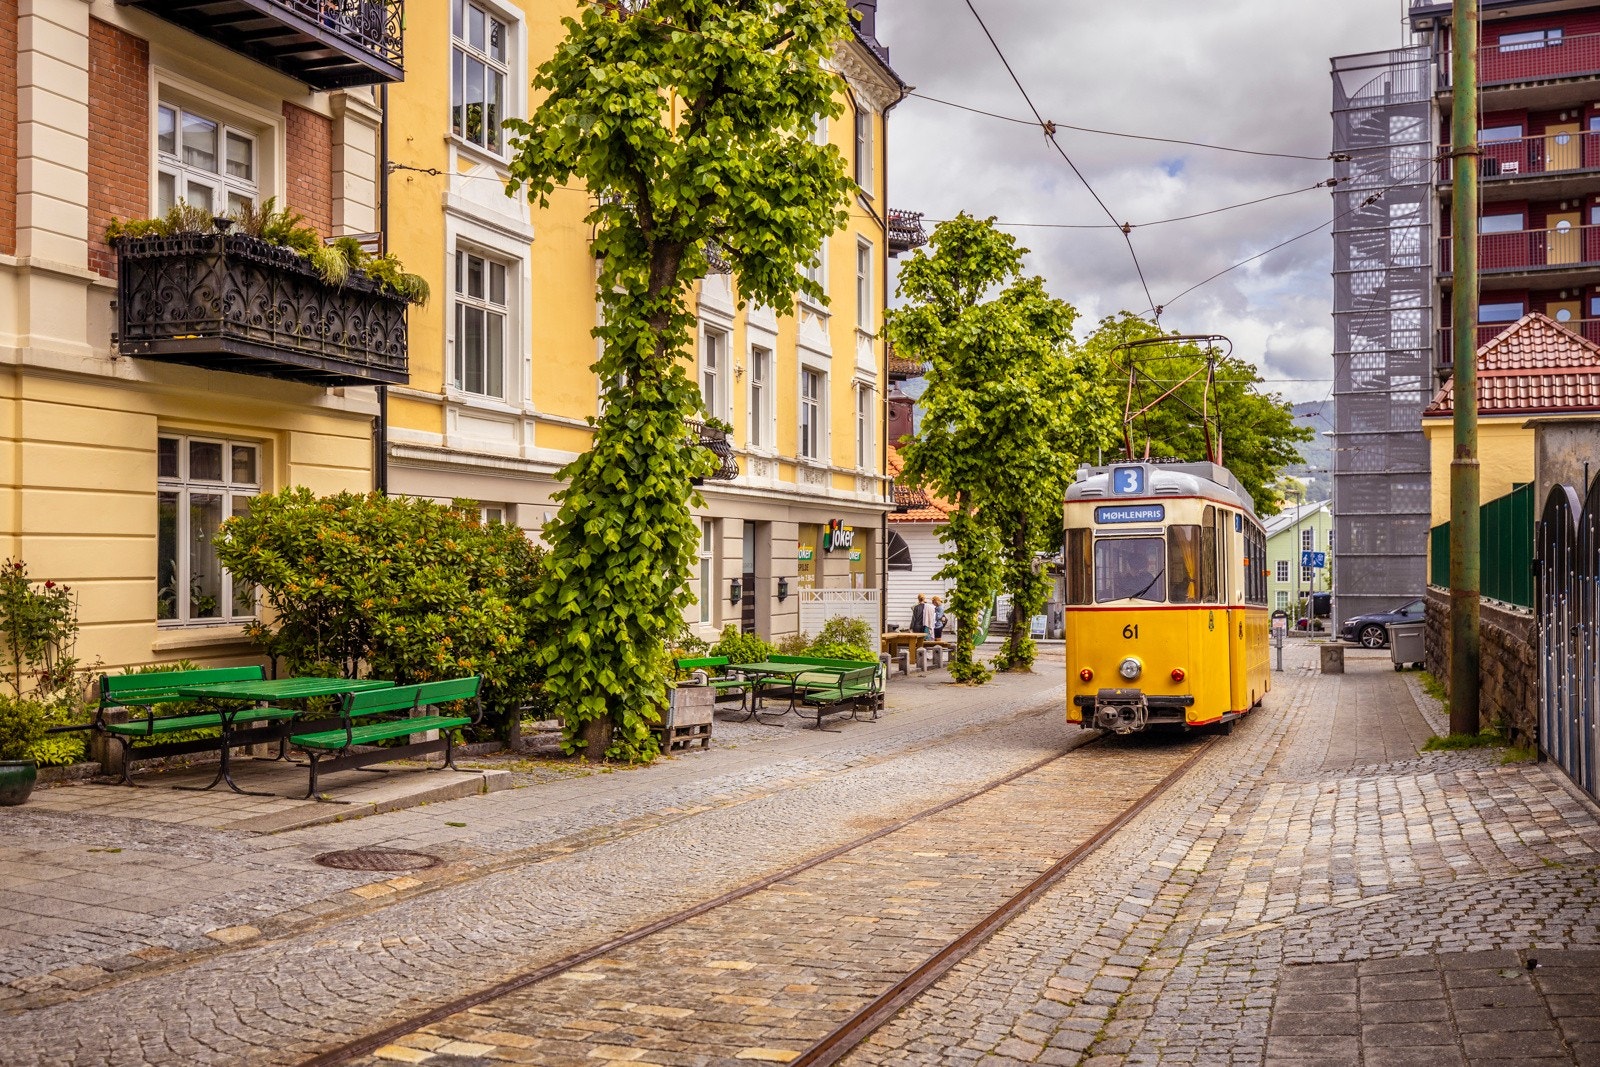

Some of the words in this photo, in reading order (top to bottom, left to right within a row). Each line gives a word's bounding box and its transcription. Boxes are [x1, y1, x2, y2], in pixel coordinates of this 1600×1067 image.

[1123, 469, 1138, 493] 3
[1102, 510, 1161, 520] MØHLENPRIS
[829, 519, 854, 552] joker
[1122, 624, 1138, 639] 61
